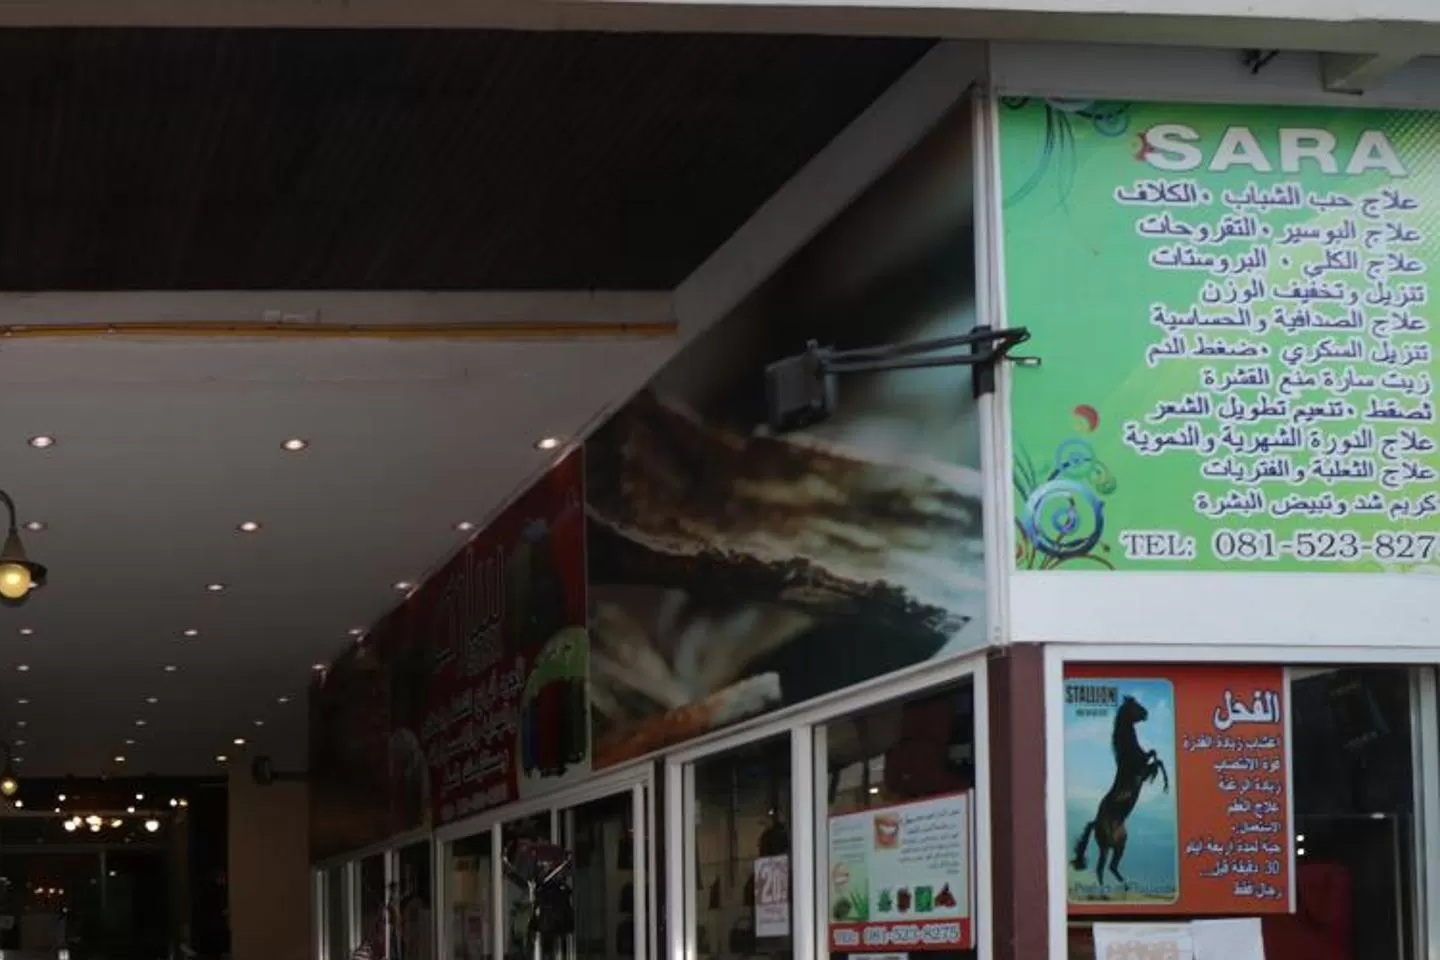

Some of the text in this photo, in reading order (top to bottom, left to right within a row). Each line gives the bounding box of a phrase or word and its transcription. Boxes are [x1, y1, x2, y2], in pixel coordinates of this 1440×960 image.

[1146, 124, 1408, 176] SARA
[1224, 184, 1300, 211] الشباب
[1309, 193, 1352, 210] حب
[1361, 189, 1419, 218] علاج
[1365, 222, 1420, 248] علاج
[1366, 252, 1424, 279] علاج
[1201, 279, 1425, 307] تنزيل وتخفيف الوزن
[1152, 306, 1267, 332] والحساسية
[1371, 311, 1426, 337] علاج
[1146, 338, 1186, 366] الدم
[1282, 340, 1363, 365] السكري
[1371, 342, 1429, 366] تنزيل
[1202, 367, 1431, 395] زيت سارة منع القشرة
[1150, 398, 1210, 420] الشعر
[1217, 397, 1287, 420] تطويل
[1125, 424, 1434, 459] علاج الدورة الشهرية والدموية
[1381, 461, 1435, 487] علاج
[1195, 491, 1263, 516] البشرة
[1354, 495, 1383, 512] شد
[1390, 492, 1439, 519] كريم
[1122, 531, 1440, 558] TEL: 081-523-827
[1212, 690, 1280, 731] الفحل
